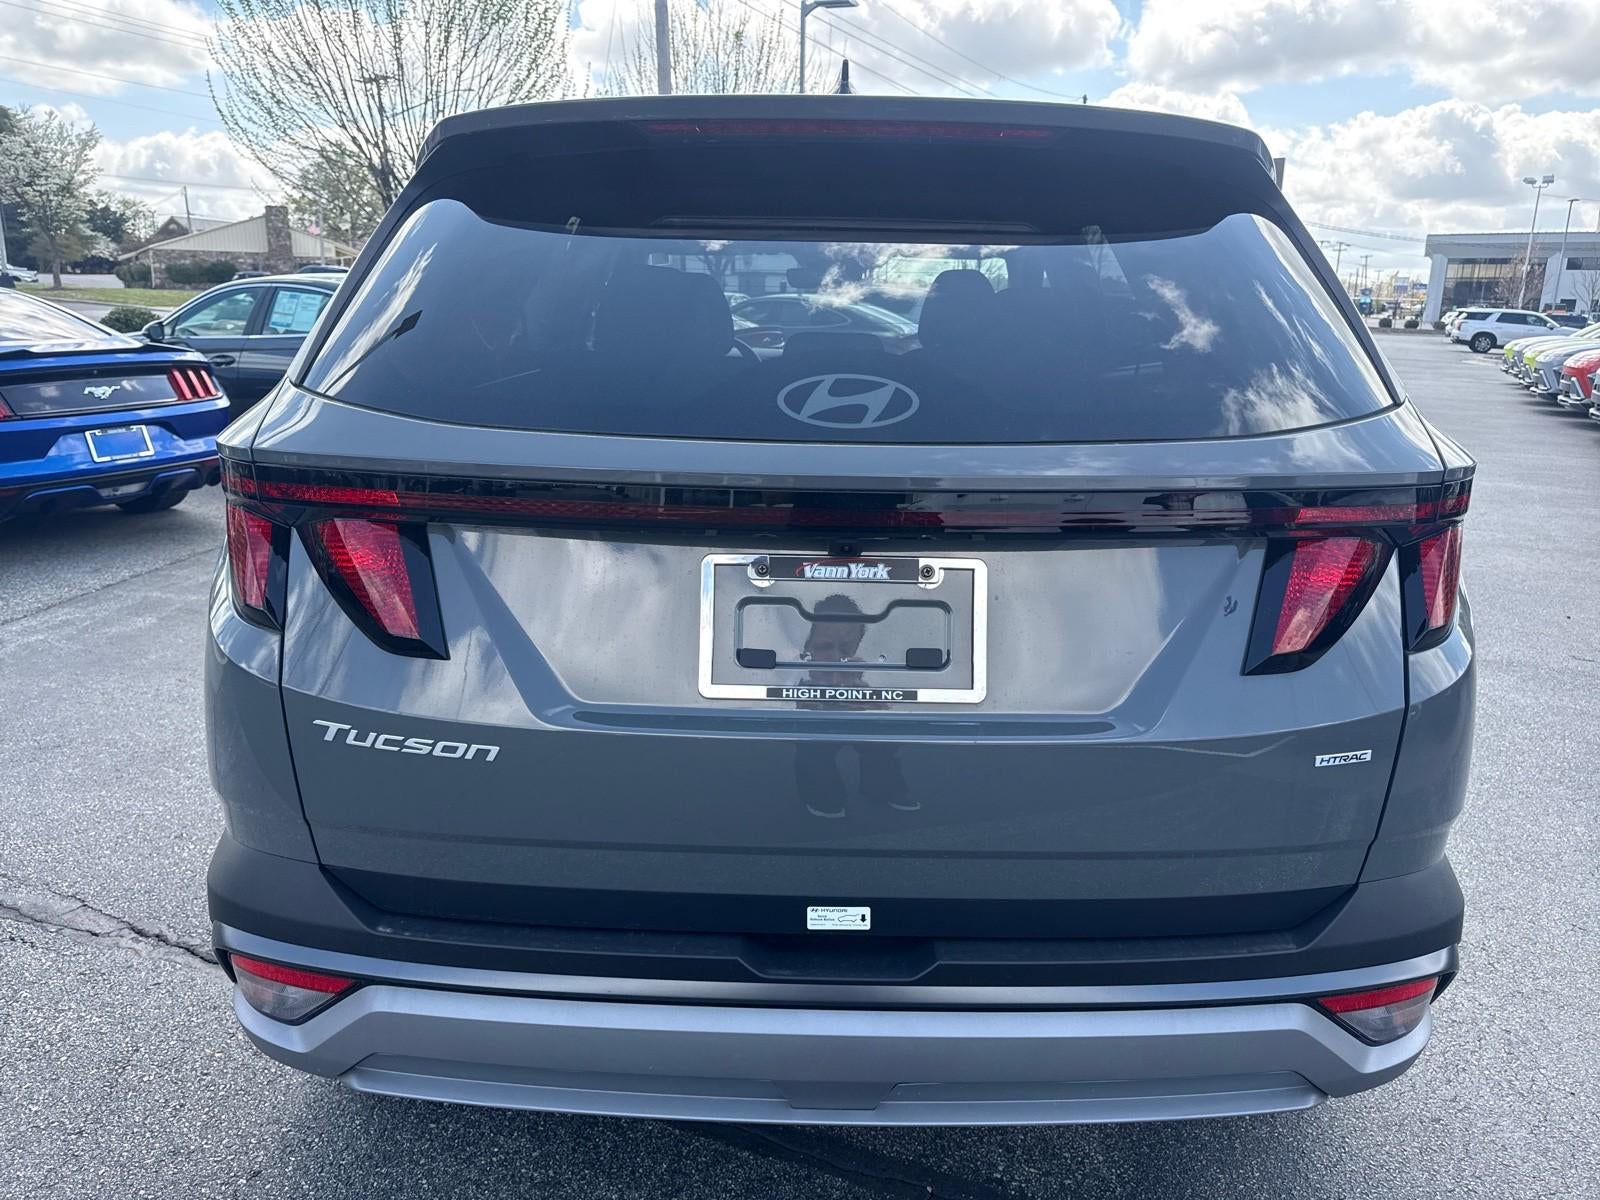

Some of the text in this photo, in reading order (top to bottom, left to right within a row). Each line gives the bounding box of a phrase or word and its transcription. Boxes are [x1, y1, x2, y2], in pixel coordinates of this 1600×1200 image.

[803, 562, 892, 579] Vann York
[782, 689, 820, 698] HIGH
[881, 691, 903, 700] NC
[1319, 752, 1369, 765] HTRAC
